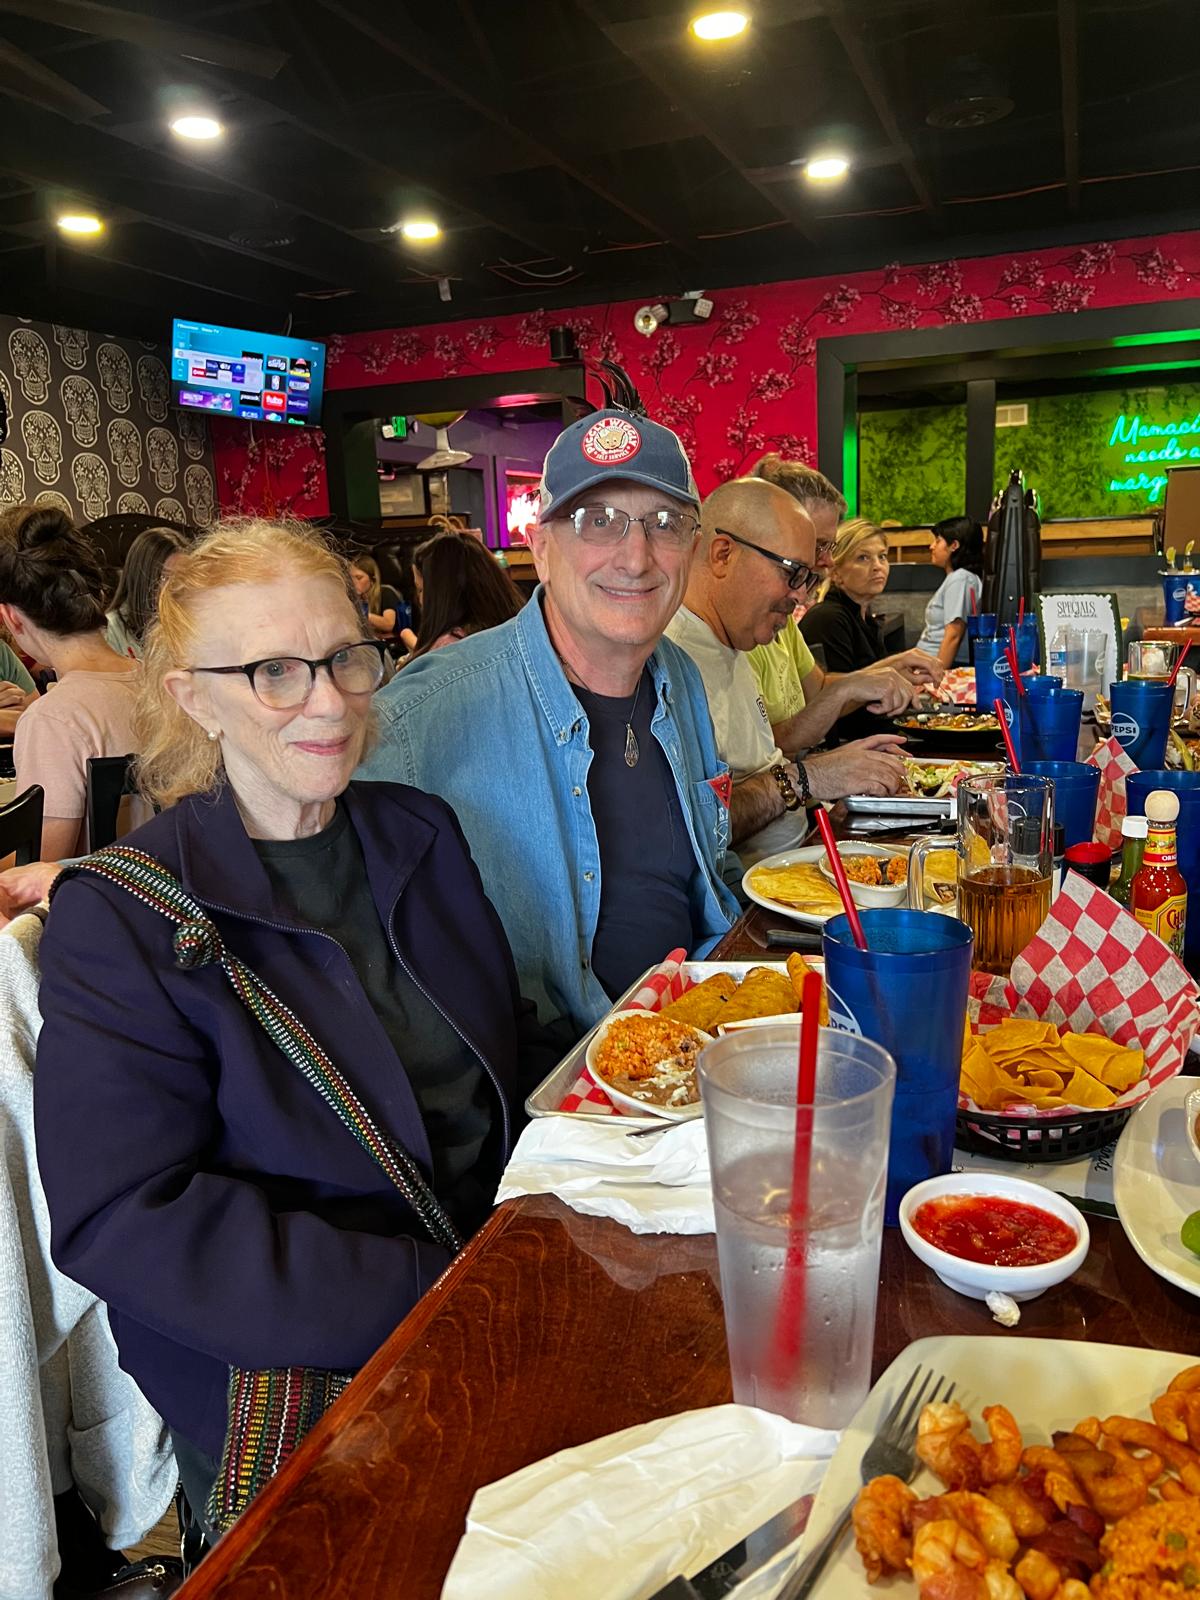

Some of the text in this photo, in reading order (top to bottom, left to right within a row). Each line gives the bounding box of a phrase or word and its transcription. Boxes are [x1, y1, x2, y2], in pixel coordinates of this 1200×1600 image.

[1124, 437, 1188, 463] needs
[1110, 472, 1169, 502] marg
[1056, 600, 1096, 614] SPECIALS
[1111, 724, 1137, 734] PEPSI
